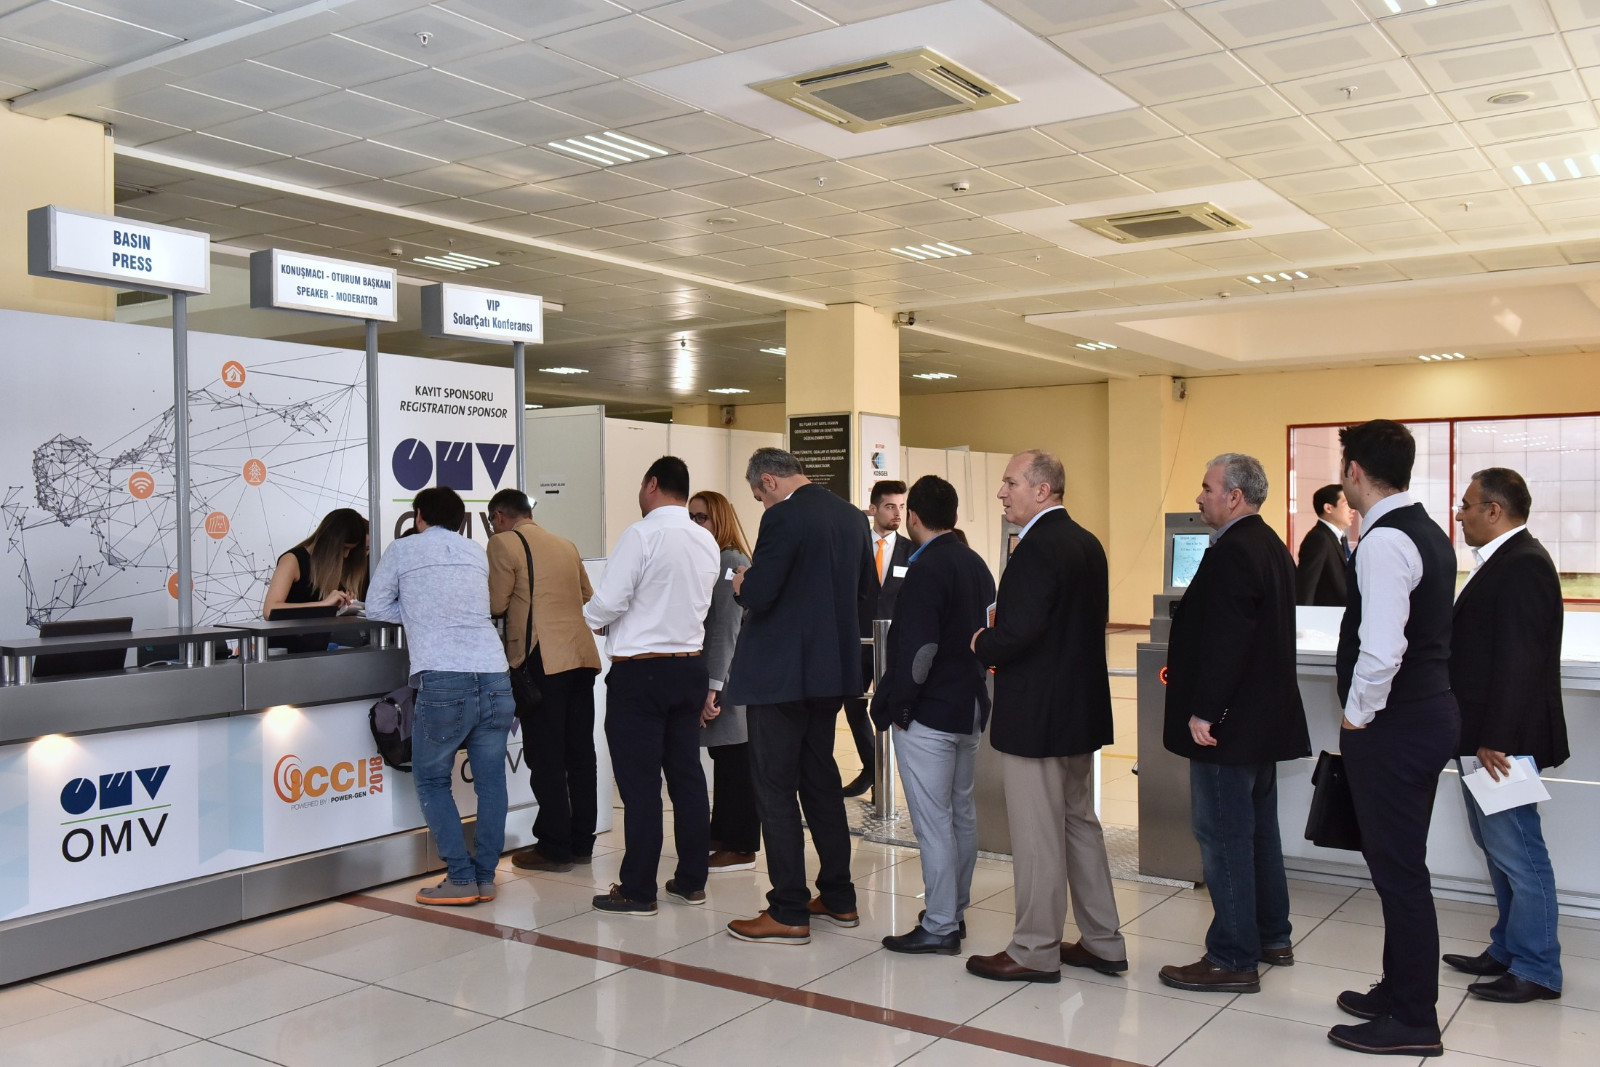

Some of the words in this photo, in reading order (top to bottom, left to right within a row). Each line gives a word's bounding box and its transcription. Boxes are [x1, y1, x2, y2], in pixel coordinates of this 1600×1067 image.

[113, 230, 151, 251] BASIN
[112, 252, 152, 272] PRESS
[281, 264, 324, 279] KONUŞMACI
[331, 272, 361, 285] OTURUM
[362, 277, 391, 289] BAŞKANI
[296, 286, 329, 299] SPEAKER
[336, 292, 378, 306] MODERATOR
[486, 299, 500, 311] VIP
[492, 317, 533, 332] Konferansı
[415, 385, 441, 397] KAYIT
[444, 388, 494, 401] SPONSORU
[400, 401, 465, 415] REGISTRATION
[467, 406, 507, 418] SPONSOR
[369, 755, 383, 795] 2018
[291, 800, 320, 811] POWERED
[330, 791, 367, 804] POWER-GEN
[62, 813, 169, 863] OMV
